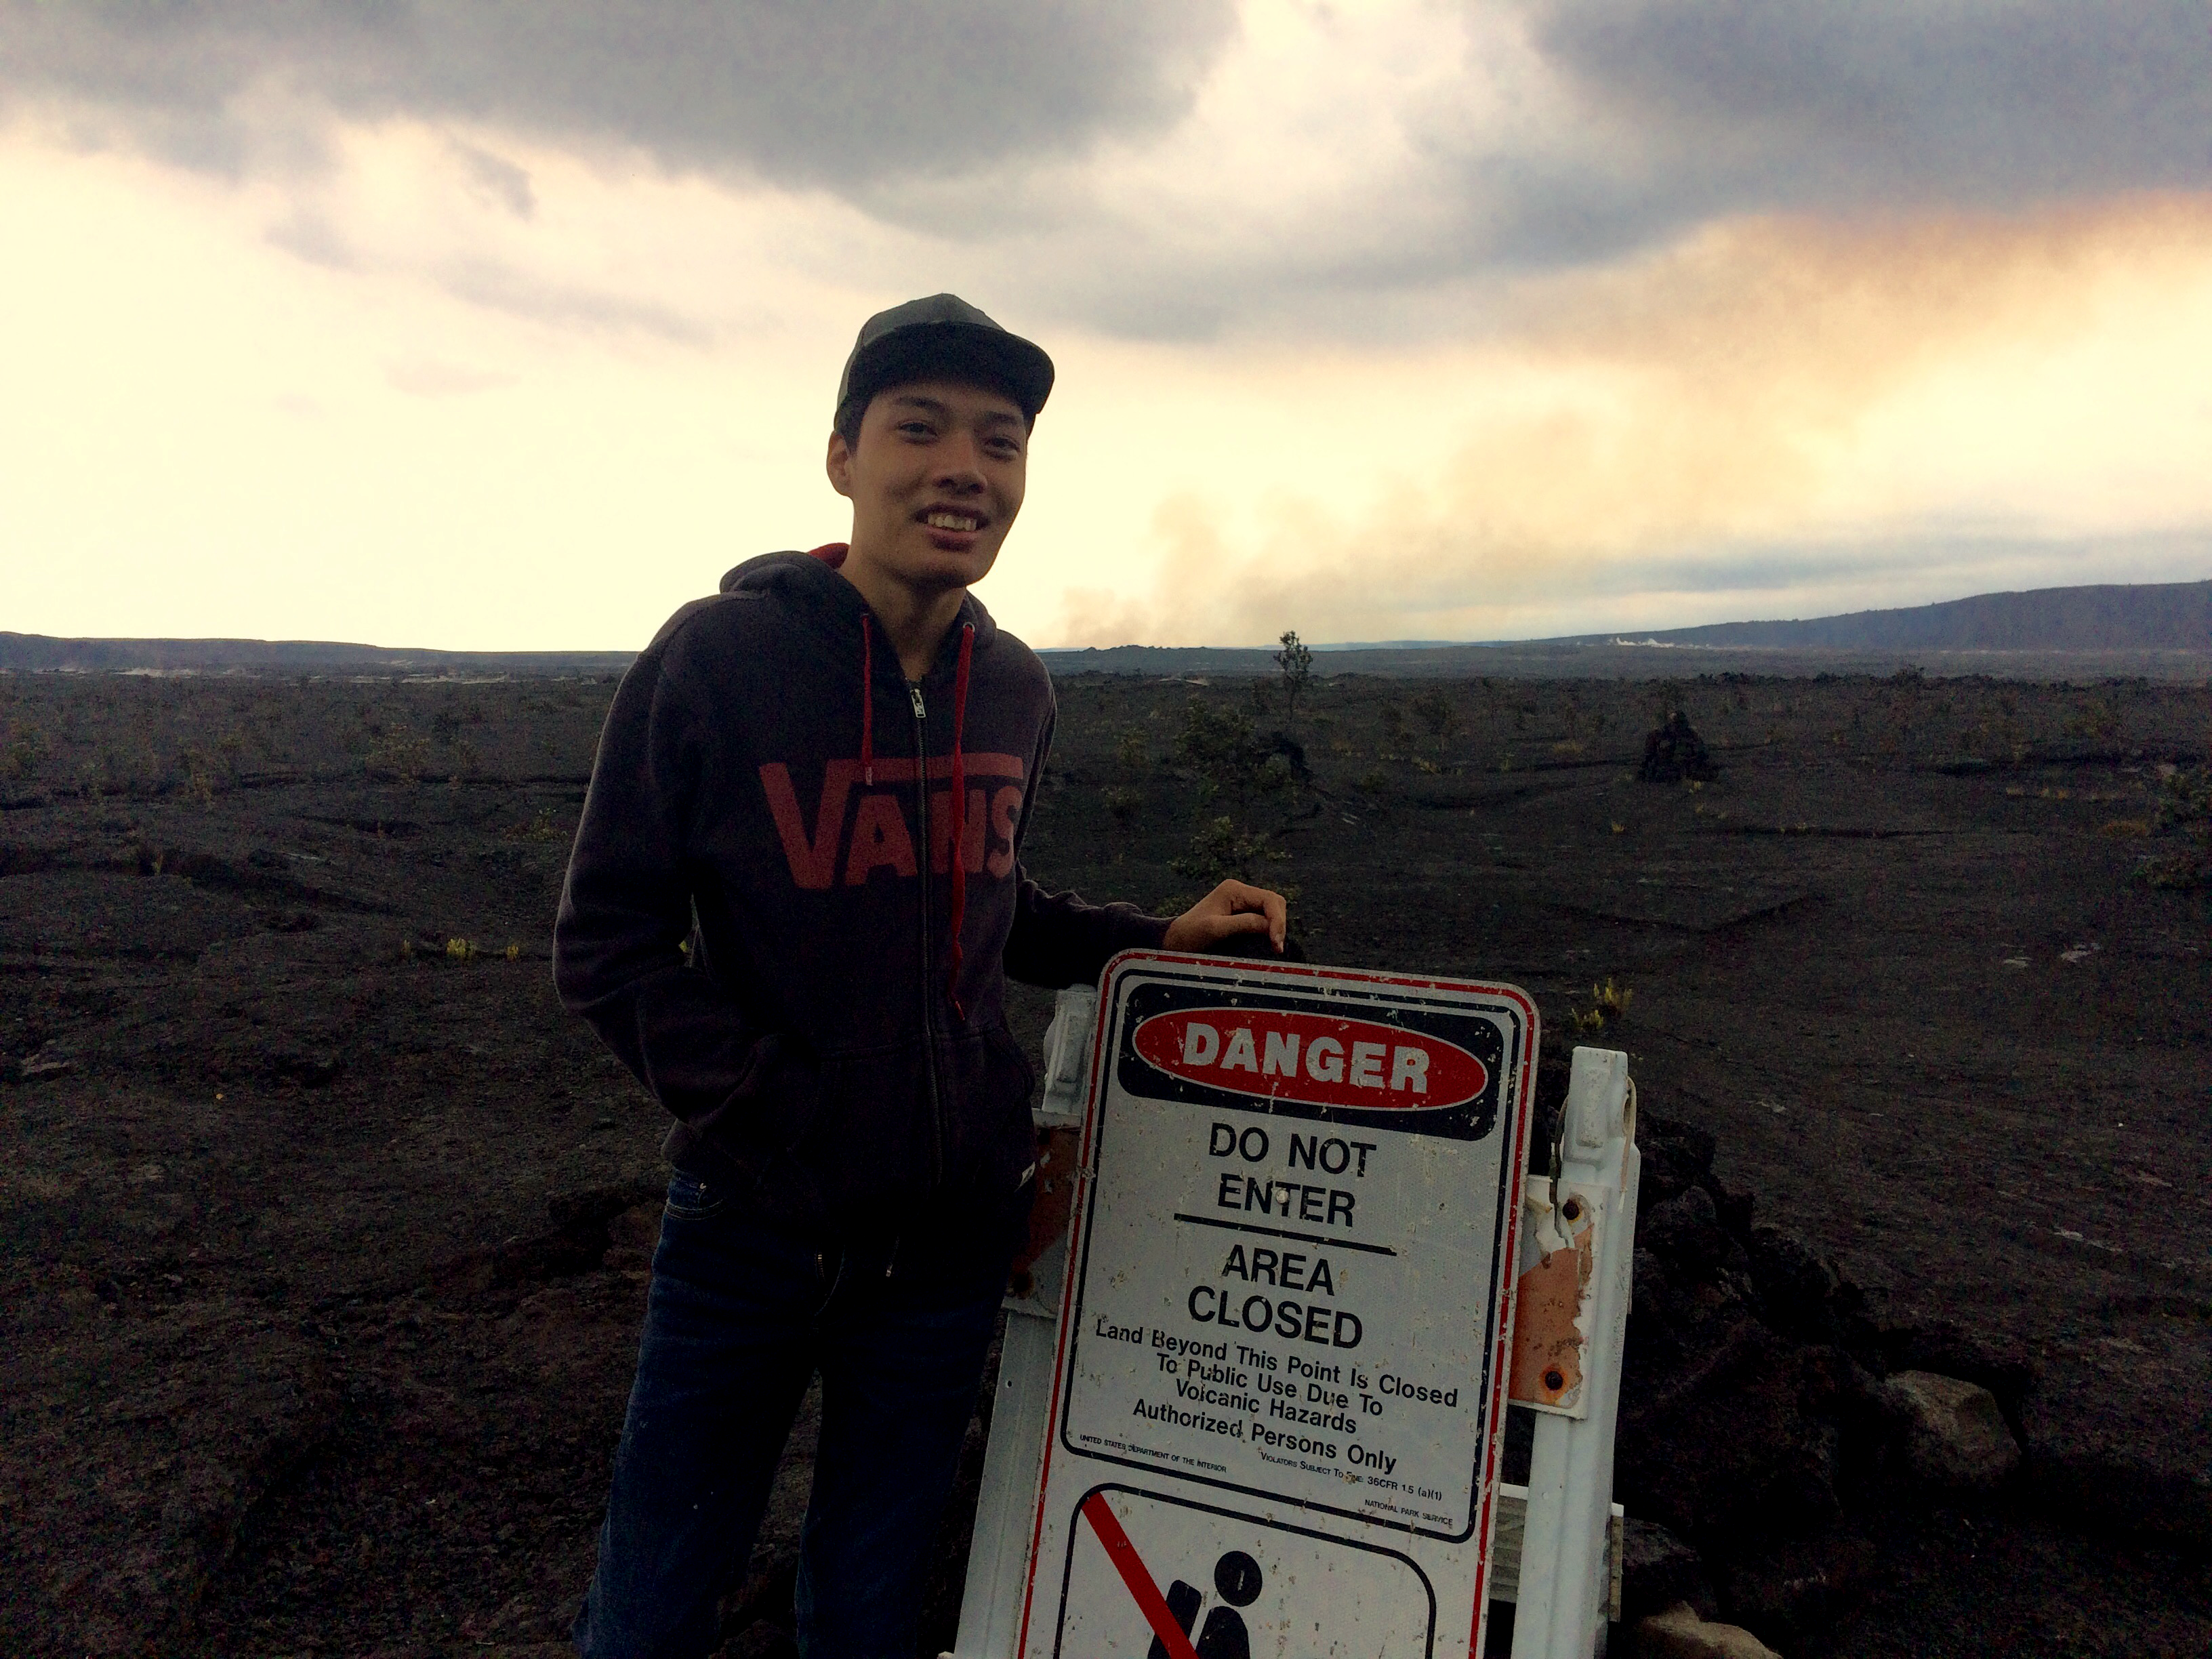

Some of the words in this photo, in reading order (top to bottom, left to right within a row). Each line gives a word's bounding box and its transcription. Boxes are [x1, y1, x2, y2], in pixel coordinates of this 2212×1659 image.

[759, 753, 1023, 890] VANS
[1183, 1021, 1431, 1094] DANGER
[1210, 1122, 1270, 1163] DO
[1289, 1133, 1377, 1178] NOT
[1218, 1174, 1356, 1227] ENTER
[1221, 1244, 1335, 1296] AREA
[1188, 1285, 1363, 1349] CLOSED
[1096, 1319, 1143, 1344] Land
[1152, 1330, 1227, 1361] Beyond
[1236, 1345, 1277, 1371] This
[1288, 1355, 1340, 1383] Point
[1351, 1368, 1368, 1389] Is
[1379, 1374, 1458, 1408] Closed
[1157, 1353, 1177, 1374] To
[1187, 1359, 1248, 1388] Public
[1258, 1373, 1297, 1398] Use
[1307, 1383, 1349, 1408] Due
[1359, 1393, 1382, 1416] To
[1176, 1378, 1260, 1413] Volcanic
[1269, 1398, 1356, 1433] Hazards
[1080, 1434, 1102, 1445] UNITED
[1104, 1439, 1126, 1450] STATES
[1128, 1444, 1169, 1459] DEPARTMENT
[1183, 1457, 1194, 1466] THE
[1197, 1460, 1227, 1473] INTERIOR
[1132, 1398, 1243, 1437] Authorized
[1252, 1422, 1337, 1458] Persons
[1347, 1444, 1397, 1475] Only
[1364, 1499, 1397, 1513] NATIONAL
[1401, 1507, 1420, 1517] PARK
[1422, 1513, 1453, 1525] SERVICE
[1368, 1476, 1398, 1490] 36CFR
[1418, 1487, 1442, 1501] (a)(1)
